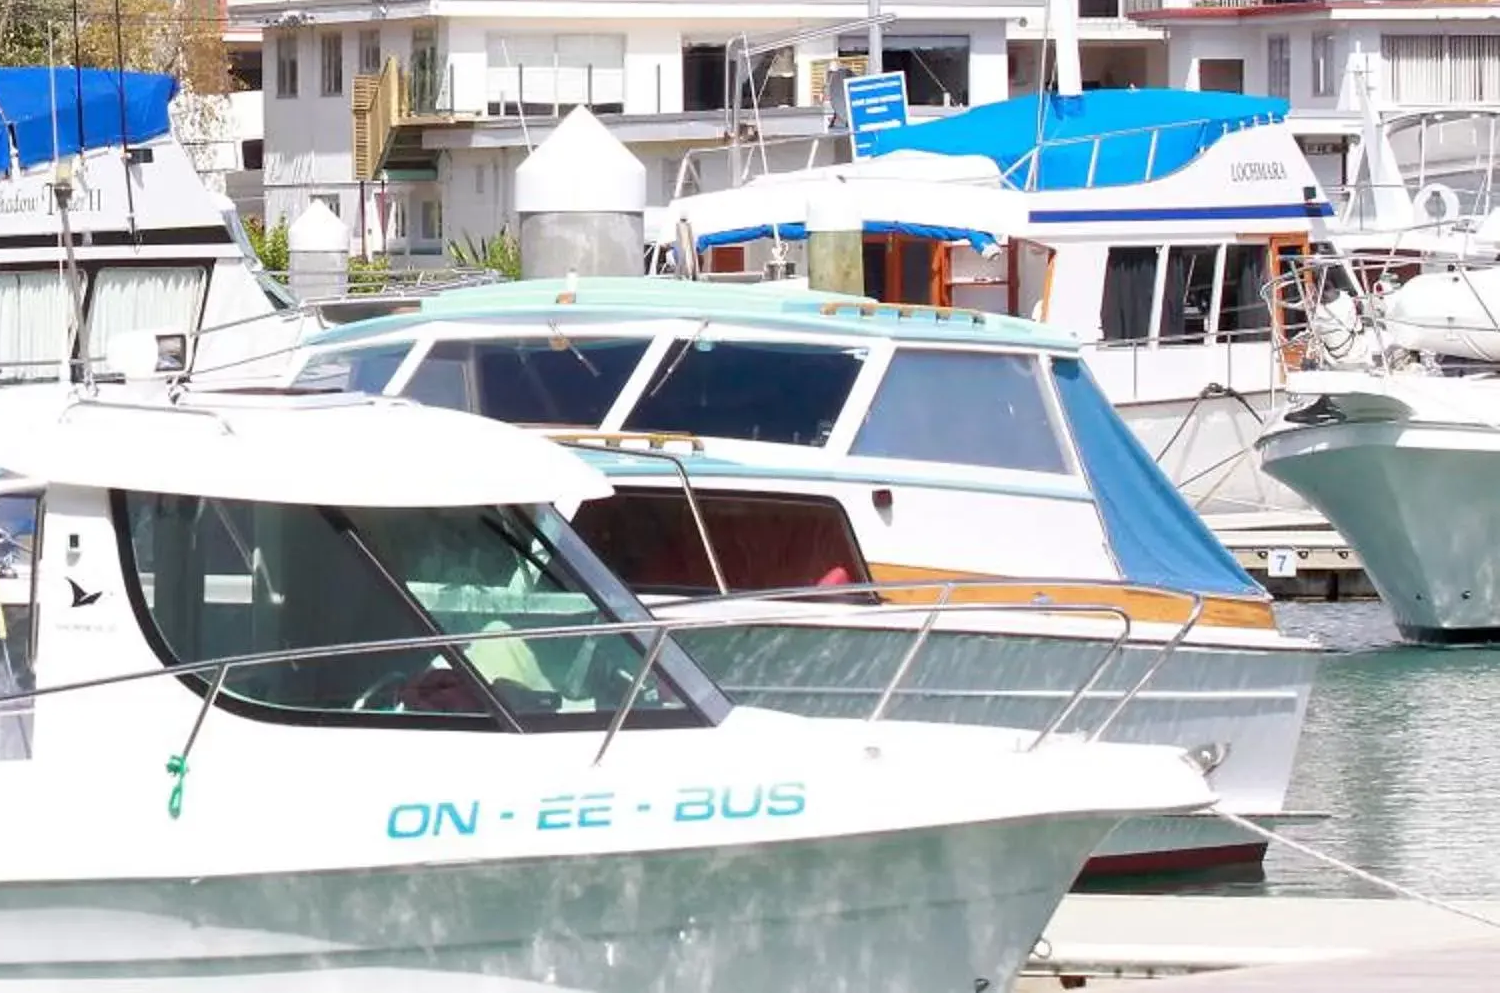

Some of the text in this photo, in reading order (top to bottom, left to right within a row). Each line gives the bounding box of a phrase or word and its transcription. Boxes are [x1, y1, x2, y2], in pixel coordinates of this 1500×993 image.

[1230, 161, 1288, 182] LOCHMARA
[1276, 554, 1287, 572] 7
[387, 800, 480, 839] ON
[536, 792, 615, 830] EE
[674, 781, 806, 822] BUS
